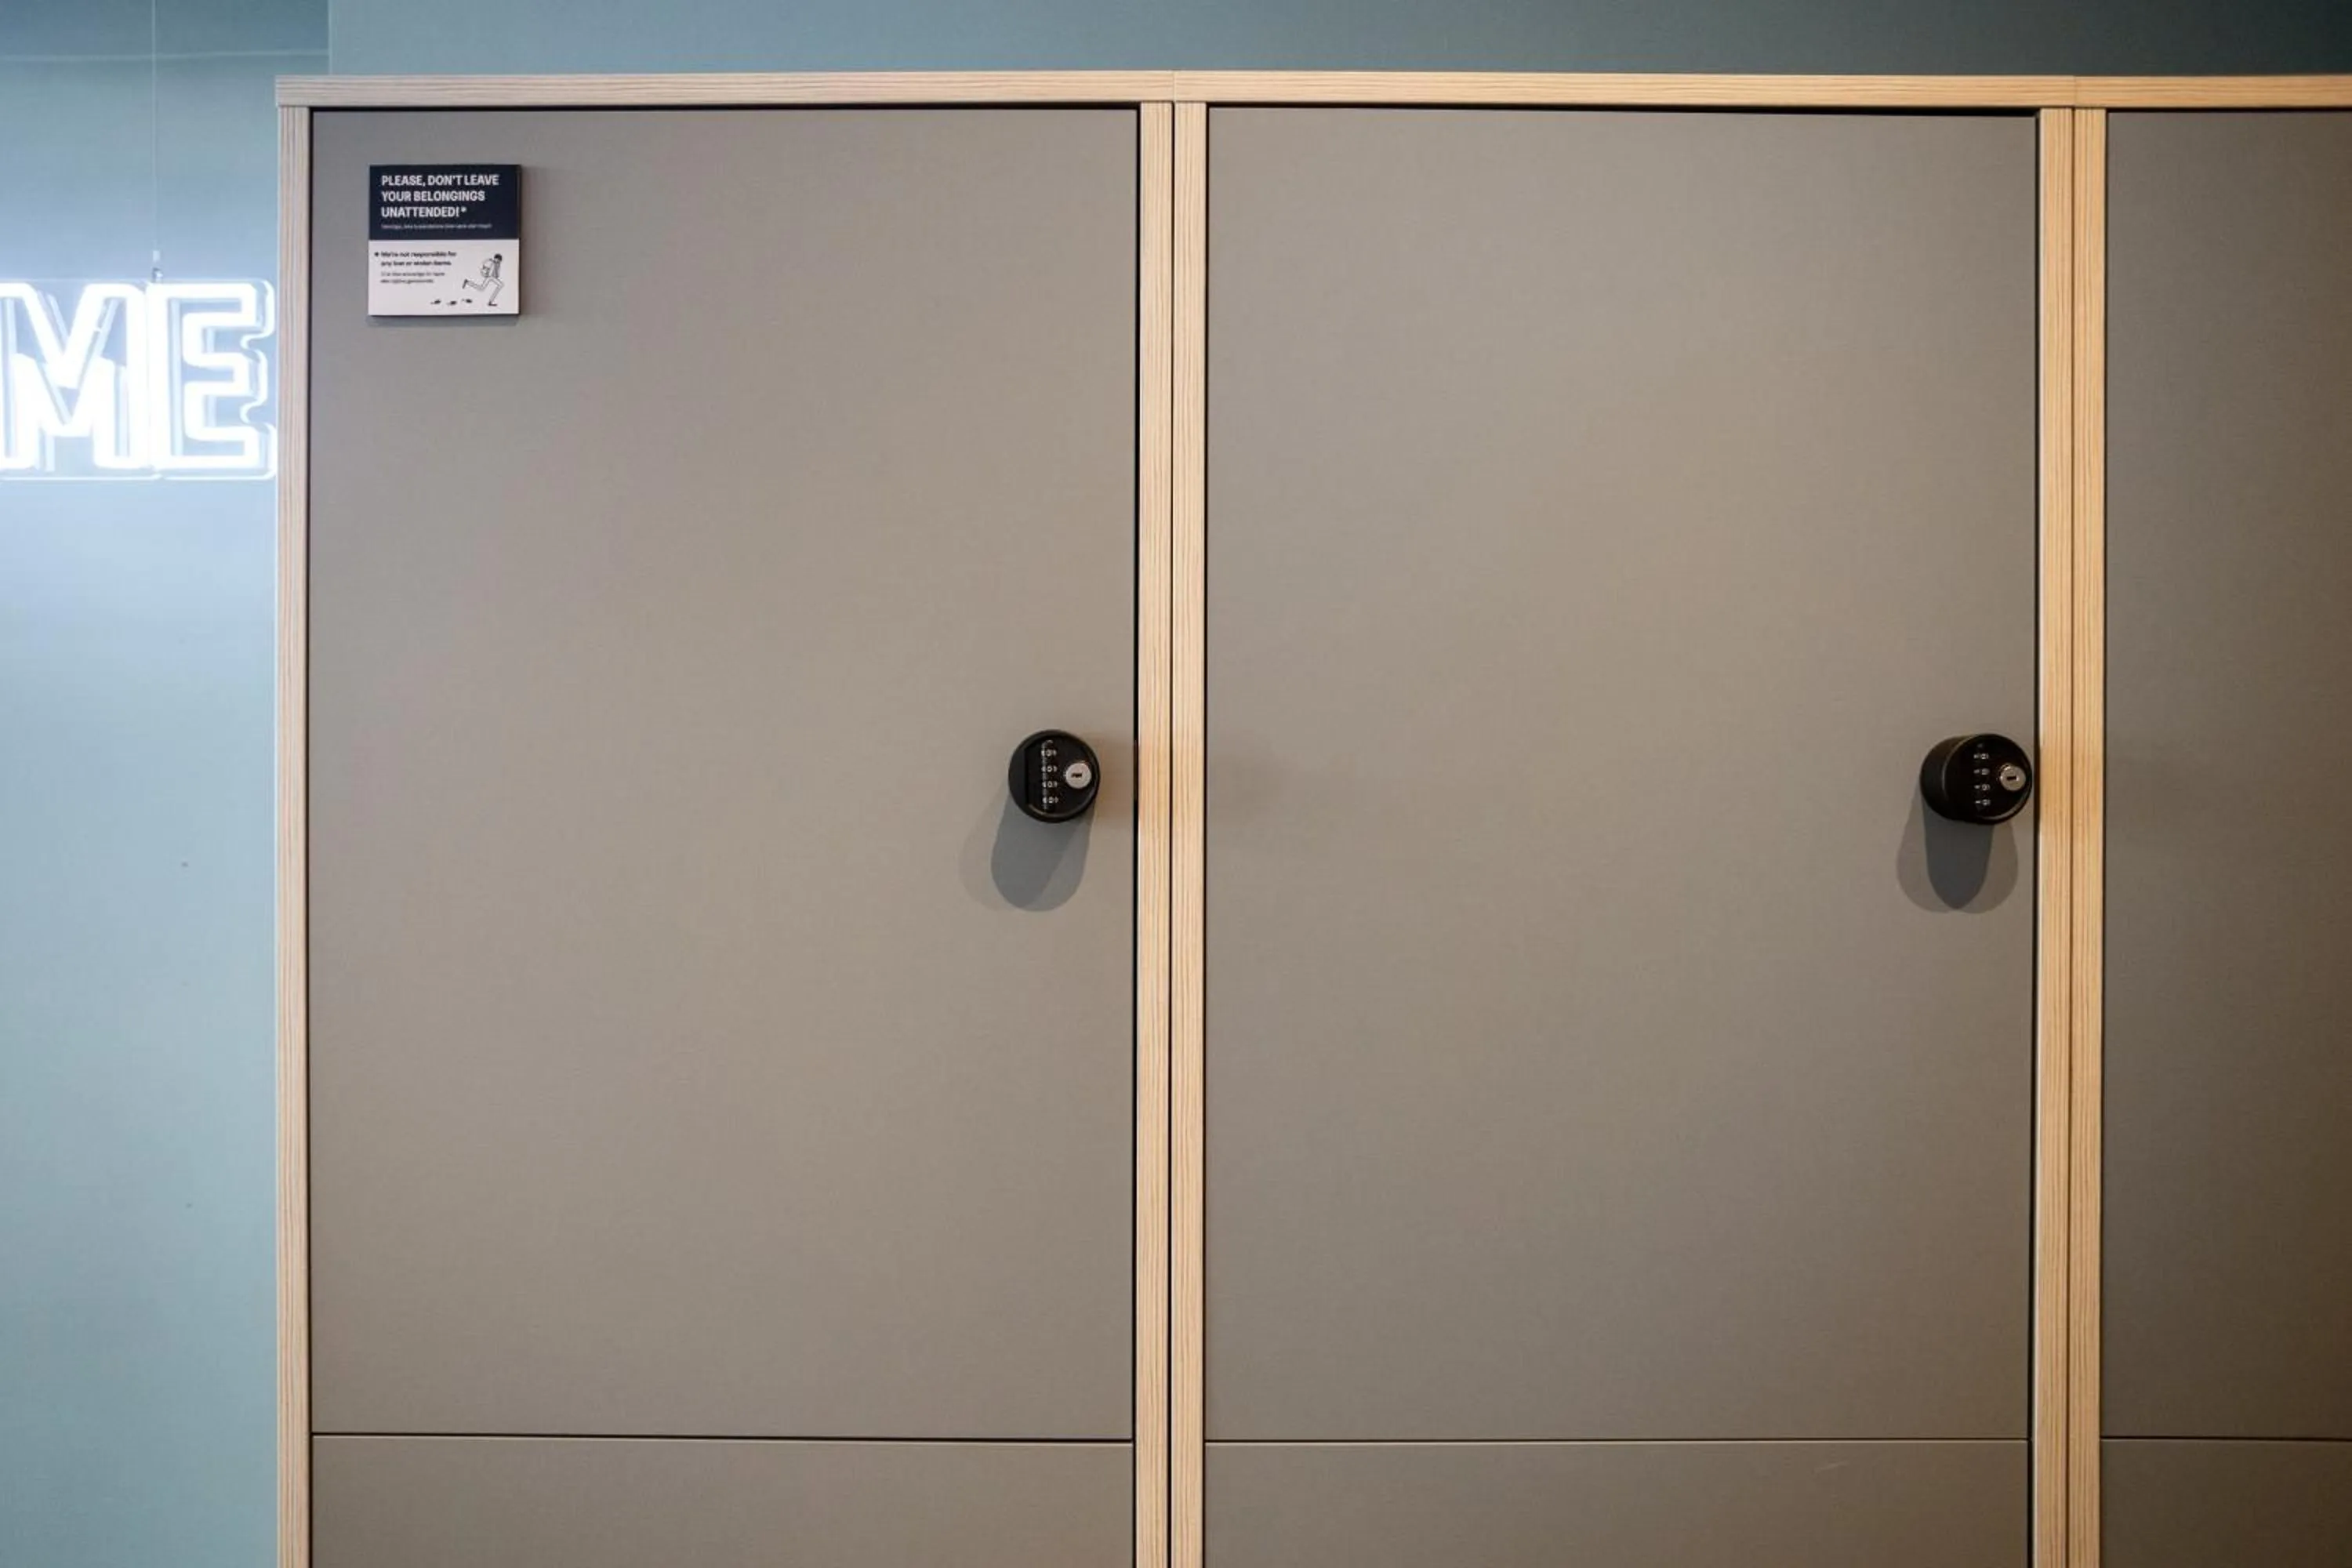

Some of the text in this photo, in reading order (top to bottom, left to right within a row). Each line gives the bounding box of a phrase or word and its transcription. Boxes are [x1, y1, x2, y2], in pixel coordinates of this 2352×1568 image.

[381, 175, 499, 187] PLEASE, DON'T LEAVE
[381, 191, 485, 201] YOUR BELONGINGS
